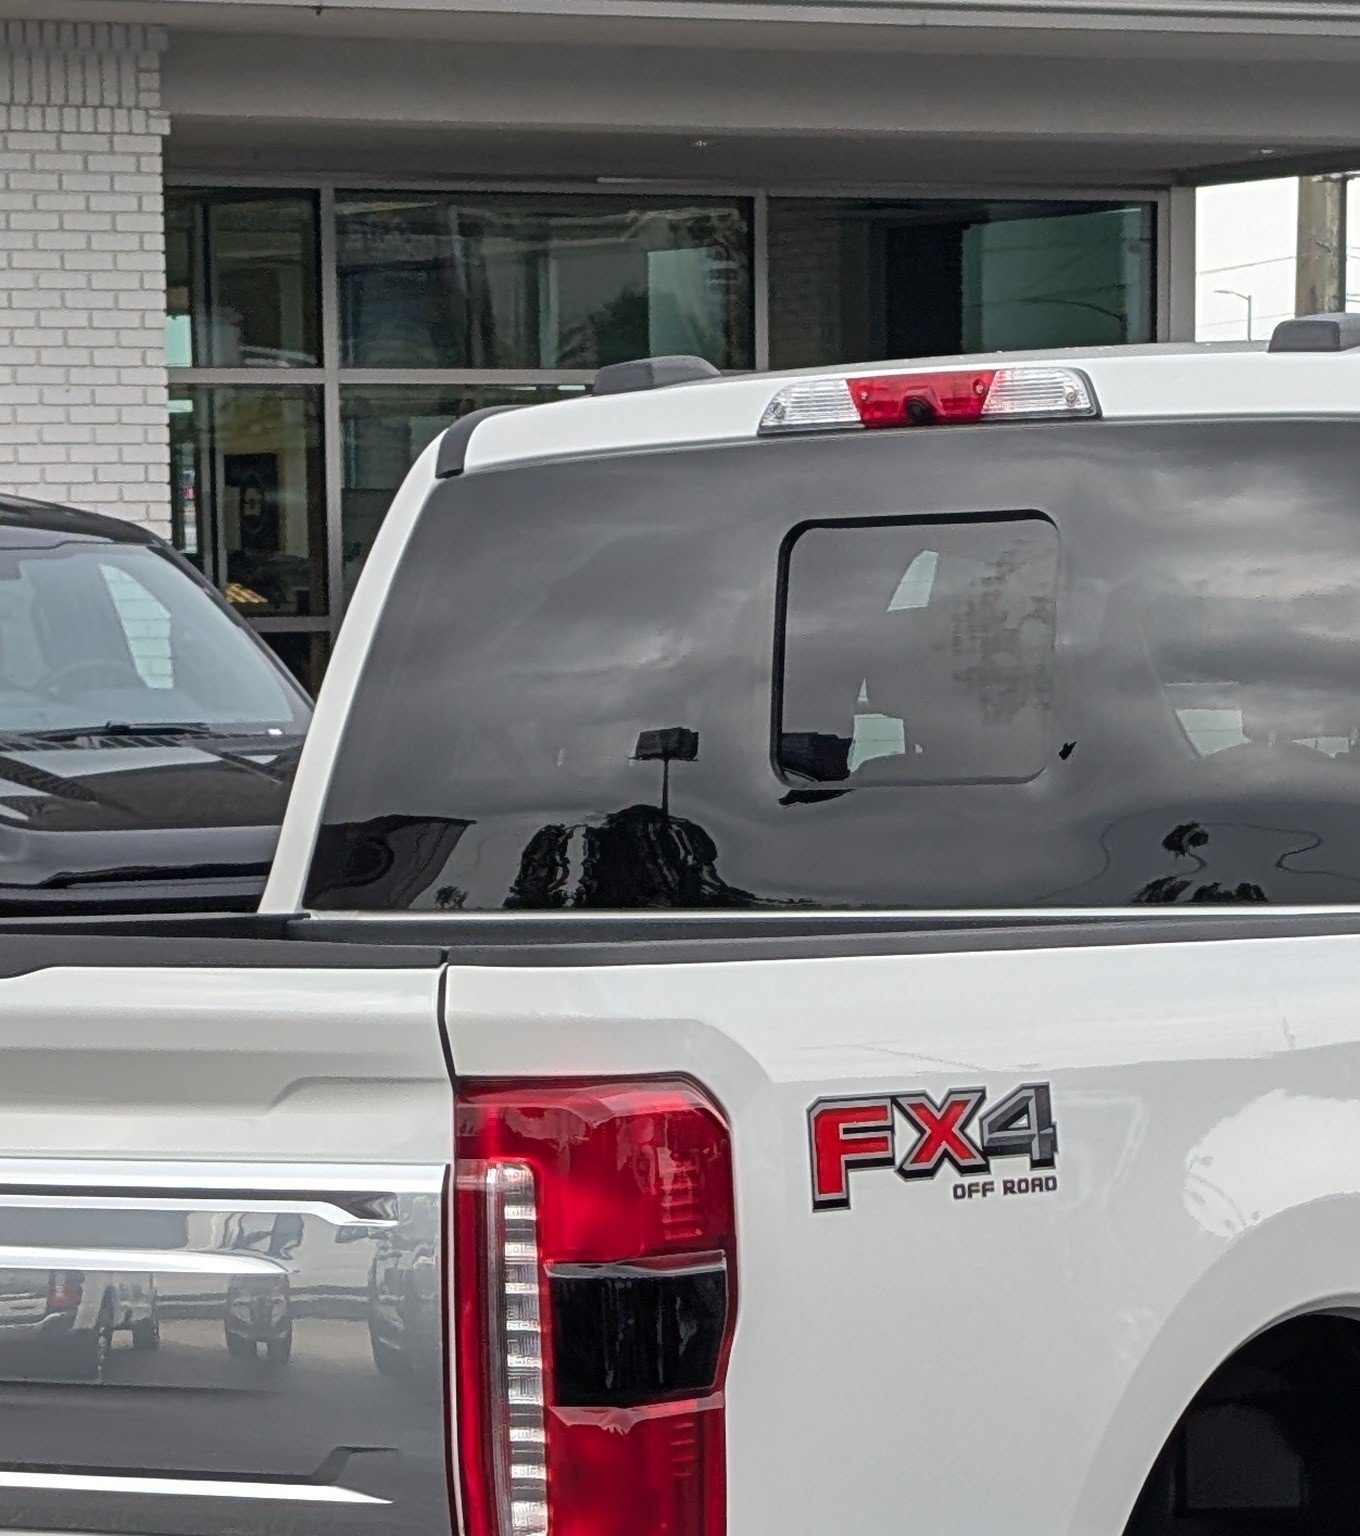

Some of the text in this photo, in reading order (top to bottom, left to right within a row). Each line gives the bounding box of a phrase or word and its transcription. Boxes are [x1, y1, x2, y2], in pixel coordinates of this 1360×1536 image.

[806, 1081, 1058, 1213] FX4
[953, 1175, 1058, 1200] OFF ROAD
